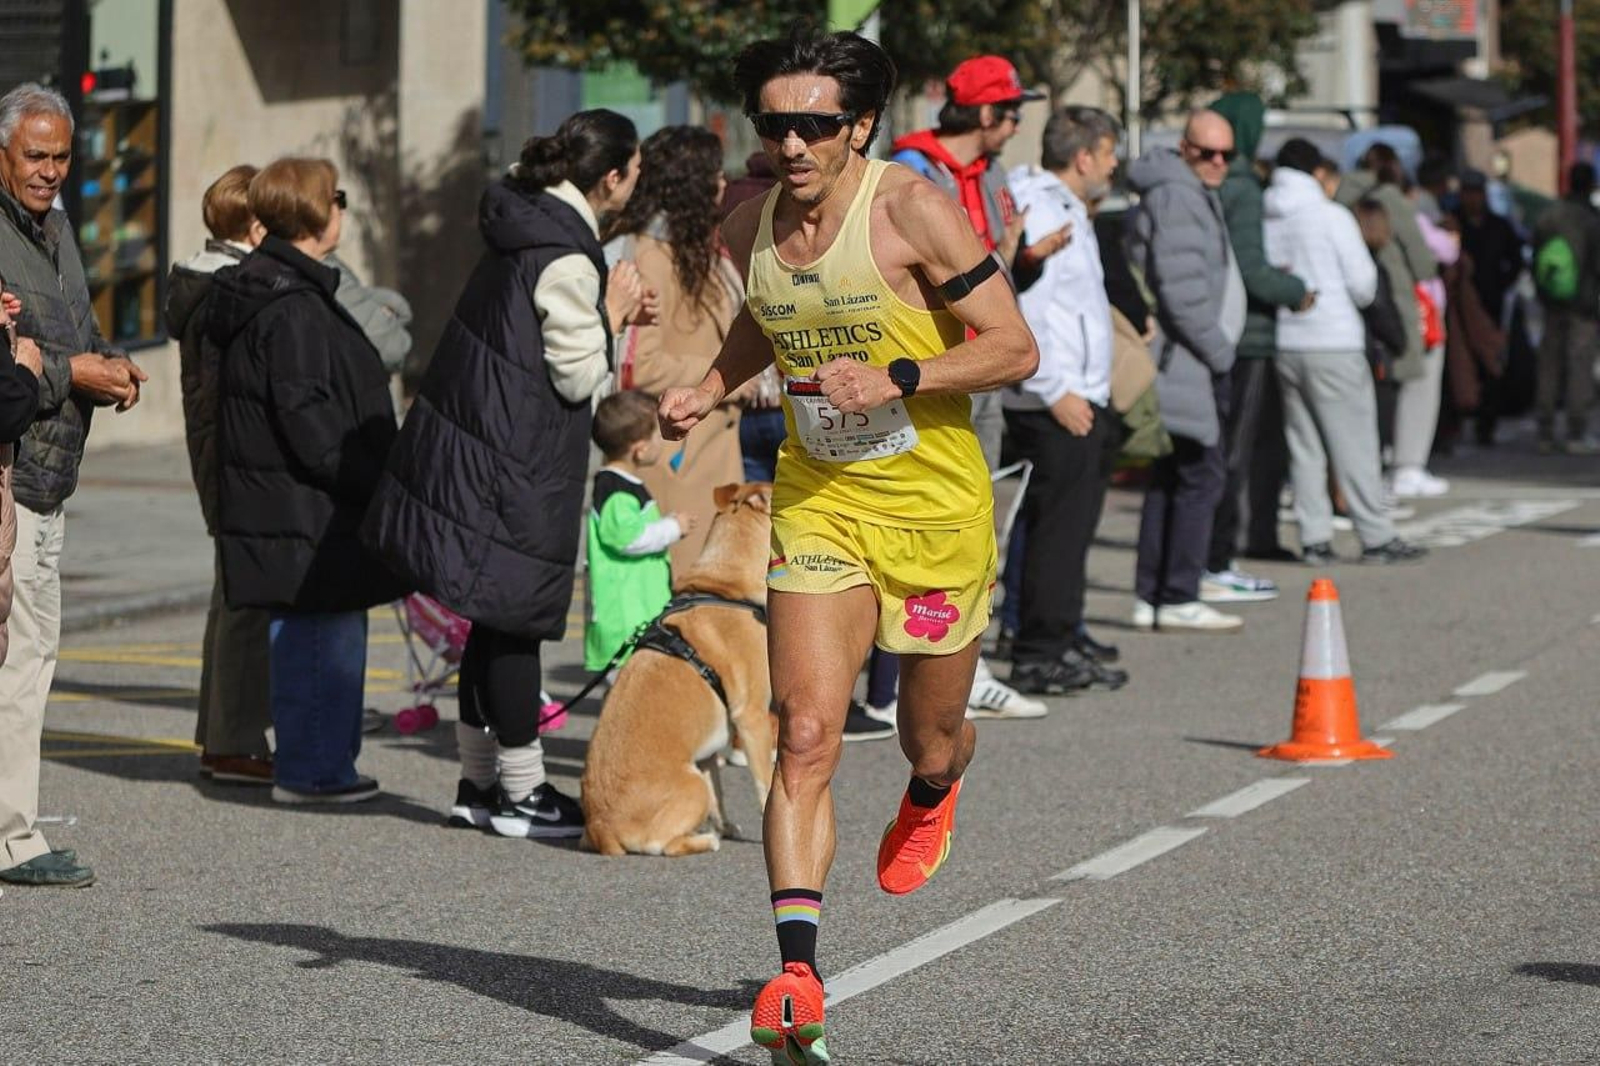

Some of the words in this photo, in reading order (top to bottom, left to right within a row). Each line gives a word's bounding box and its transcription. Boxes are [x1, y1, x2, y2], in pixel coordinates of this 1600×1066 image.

[823, 297, 841, 308] San
[841, 293, 879, 306] Lázaro
[787, 352, 814, 367] San
[818, 407, 869, 430] 575
